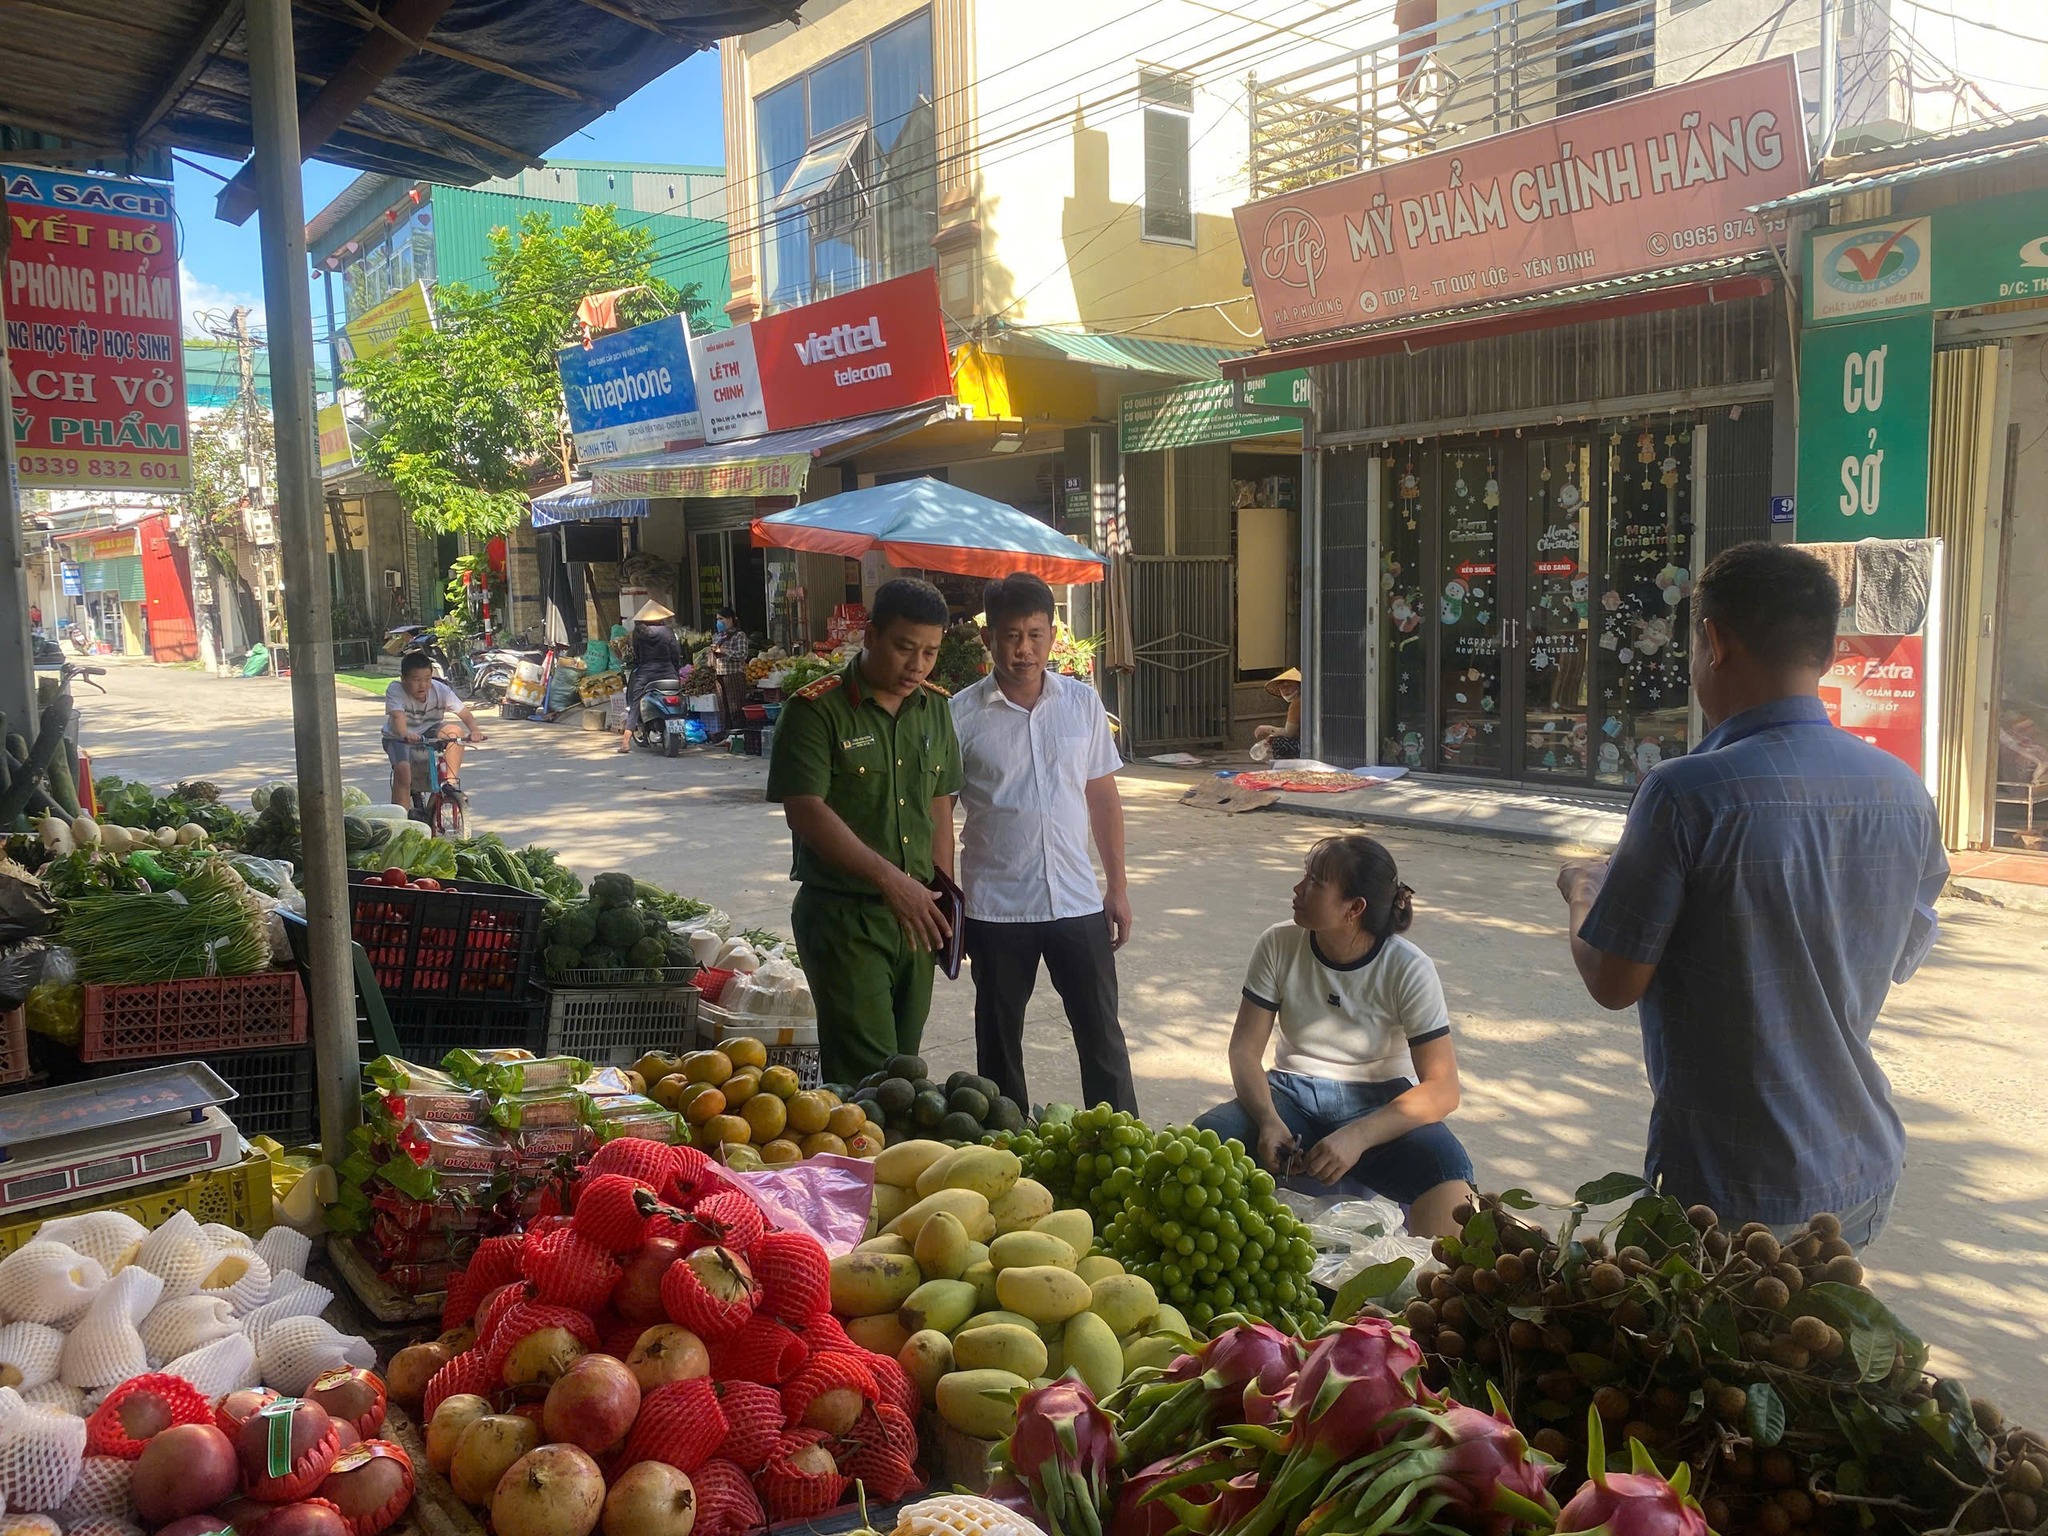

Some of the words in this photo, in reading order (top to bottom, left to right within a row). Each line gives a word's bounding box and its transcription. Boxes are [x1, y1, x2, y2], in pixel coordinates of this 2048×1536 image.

[4, 175, 43, 199] À
[52, 184, 168, 217] SÁCH
[1344, 194, 1395, 262] MỸ
[1400, 158, 1507, 250] PHẨM
[1510, 141, 1642, 224] CHÍNH
[1646, 110, 1784, 196] HÃNG
[11, 214, 95, 247] YẾT
[1672, 224, 1718, 250] 0965
[1723, 218, 1756, 242] 874
[9, 252, 97, 313] PHÒNG
[102, 257, 174, 320] PHẨM
[1410, 285, 1420, 301] 2
[1431, 279, 1447, 297] TT
[1450, 266, 1478, 293] QUÝ
[1481, 265, 1509, 289] LỘC
[1522, 256, 1553, 280] YÊN
[1556, 249, 1595, 274] ĐỊNH
[1274, 306, 1290, 323] HÀ
[1293, 298, 1344, 319] PHƯƠNG
[1909, 291, 1924, 301] TIN
[6, 321, 29, 350] NG
[32, 323, 65, 358] HỌC
[69, 320, 99, 361] TẬP
[103, 330, 134, 363] HỌC
[137, 333, 172, 362] SINH
[794, 316, 887, 366] viettel
[9, 360, 97, 403] ÁCH
[111, 368, 174, 408] VỞ
[709, 361, 722, 381] LÊ
[722, 361, 741, 378] THỊ
[834, 362, 892, 387] telecom
[1843, 344, 1888, 414] CƠ
[580, 367, 672, 411] vinaphone
[713, 383, 745, 403] CHINH
[1223, 398, 1234, 408] QU
[13, 408, 35, 442] Ỹ
[50, 411, 181, 450] PHẨM
[578, 443, 599, 459] CHINH
[19, 456, 80, 476] 0339
[87, 459, 132, 478] 832
[139, 462, 181, 480] 601
[1840, 428, 1884, 516] SỞ
[1863, 659, 1914, 679] Extra
[451, 1111, 475, 1120] ANH
[549, 1143, 573, 1152] ANH
[469, 1160, 495, 1170] ANH
